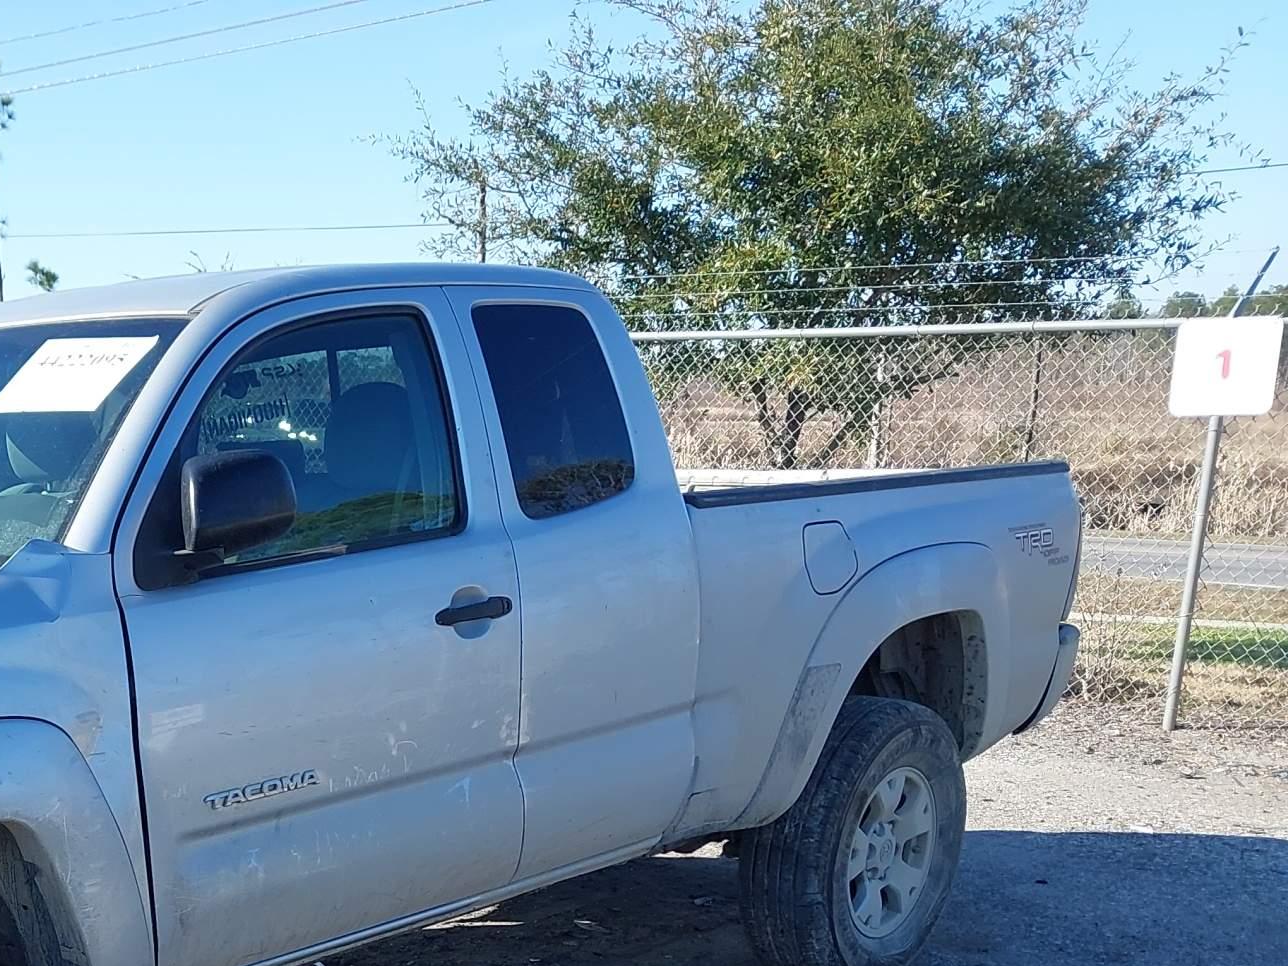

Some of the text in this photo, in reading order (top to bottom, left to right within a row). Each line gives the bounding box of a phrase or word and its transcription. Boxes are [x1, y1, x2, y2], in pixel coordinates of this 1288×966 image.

[1215, 348, 1232, 379] 1
[1015, 528, 1054, 556] TRD
[202, 768, 321, 810] TACOMA
